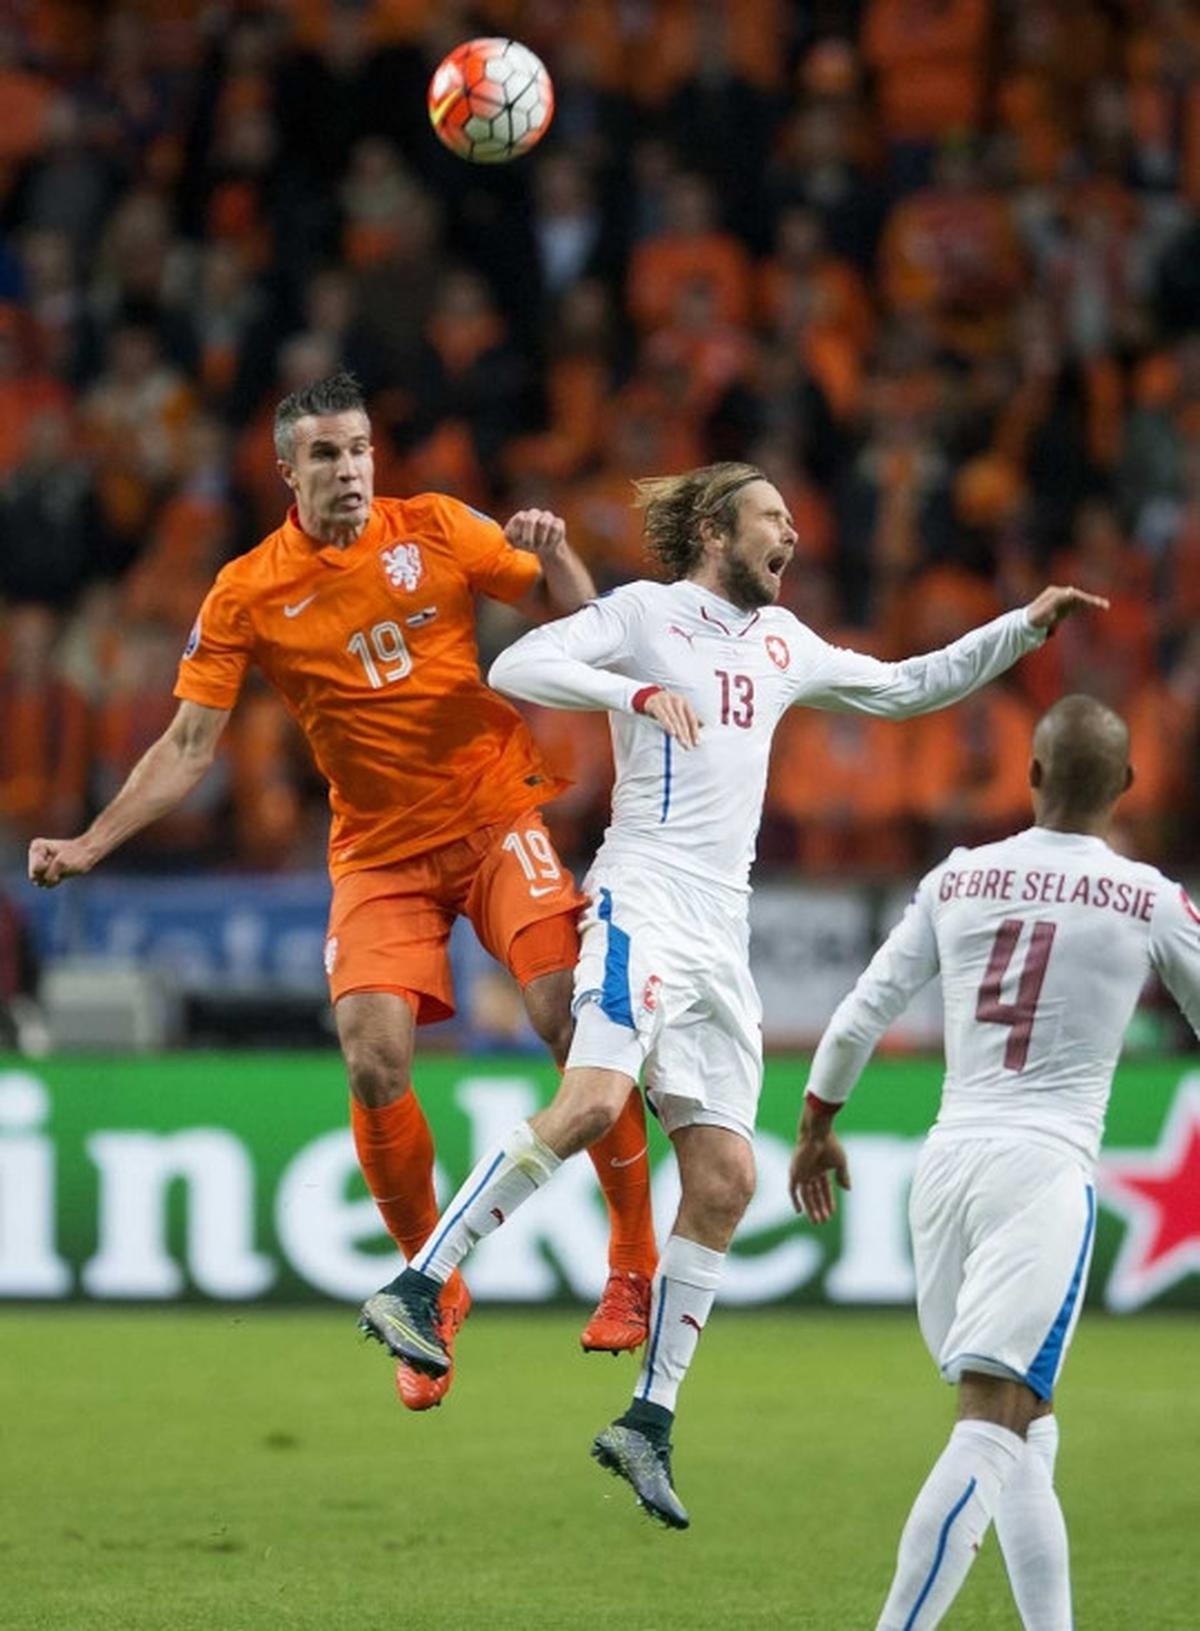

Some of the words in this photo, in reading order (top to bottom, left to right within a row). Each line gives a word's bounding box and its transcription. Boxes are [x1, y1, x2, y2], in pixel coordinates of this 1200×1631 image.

[346, 619, 413, 690] 19
[714, 669, 755, 729] 13
[501, 829, 561, 881] 19
[938, 868, 1017, 902] GEBRE
[1021, 870, 1158, 923] SELASSIE
[975, 918, 1057, 1073] 4
